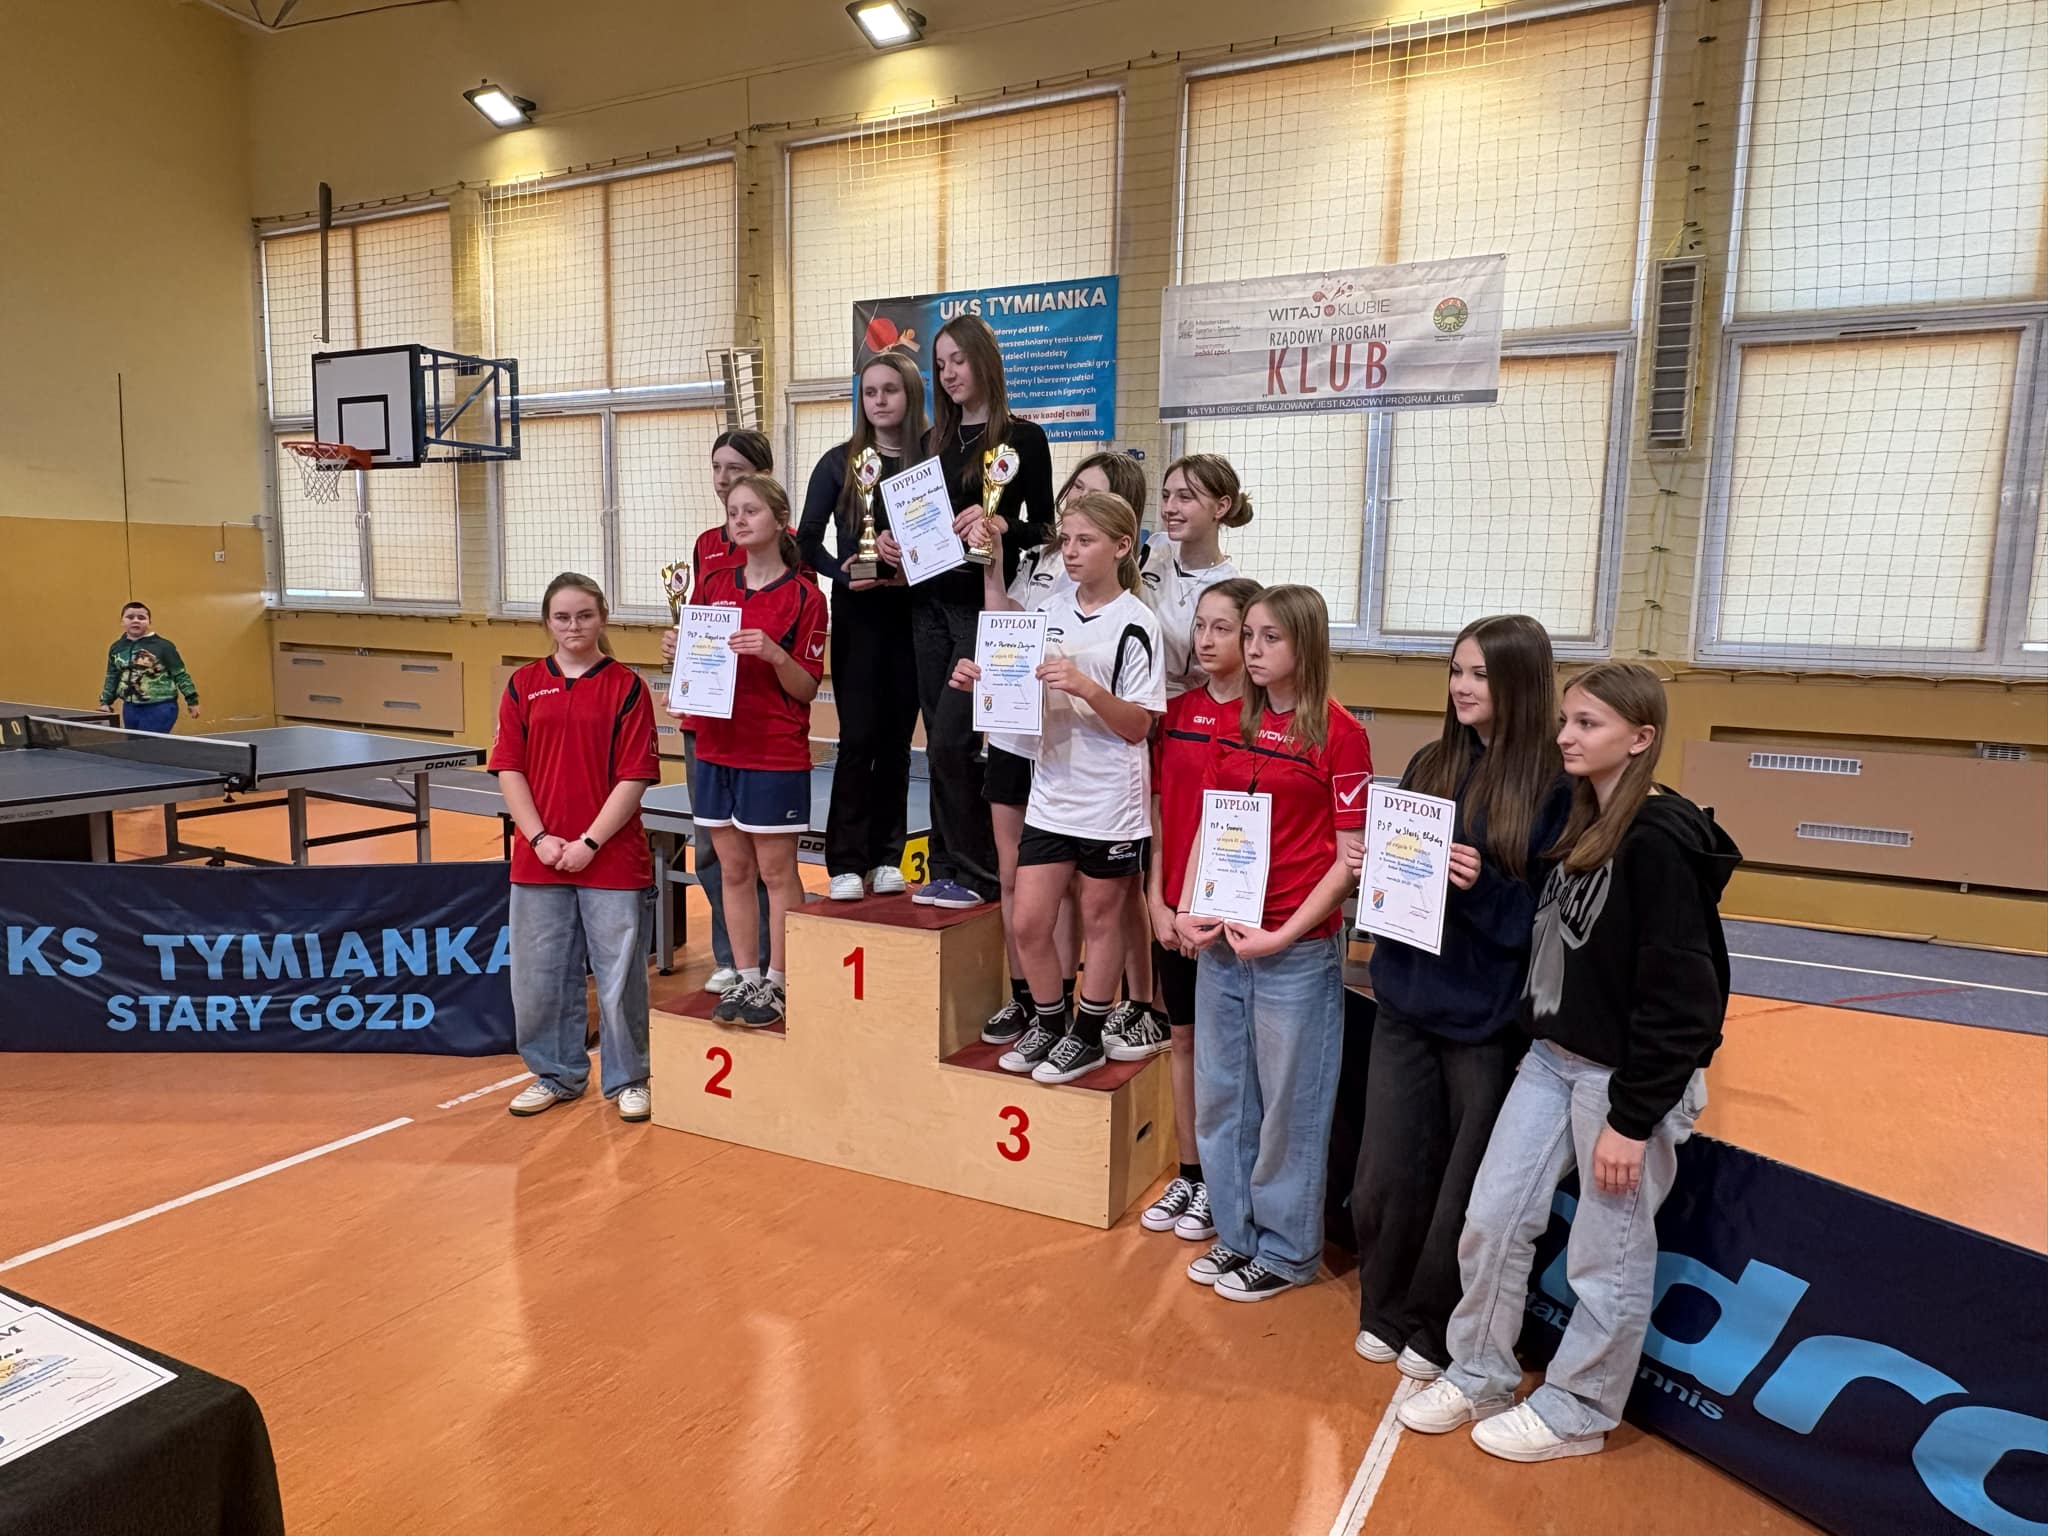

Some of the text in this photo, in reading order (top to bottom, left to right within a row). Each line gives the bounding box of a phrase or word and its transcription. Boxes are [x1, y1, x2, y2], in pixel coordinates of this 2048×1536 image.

[940, 287, 1108, 320] UKS TYMIANKA
[1268, 306, 1321, 321] WITAJ
[1338, 299, 1391, 316] KLUBIE
[1269, 324, 1387, 348] RZĄDOWY PROGRAM
[1187, 408, 1198, 416] NA
[1200, 406, 1216, 415] TYM
[1256, 401, 1316, 412] REALIZOWANY
[1316, 400, 1338, 409] JEST
[1385, 395, 1432, 405] PROGRAM
[892, 467, 932, 492] DYPLOM
[691, 611, 731, 623] DYPLOM
[990, 618, 1036, 629] DYPLOM
[424, 759, 468, 771] DONIC
[1215, 798, 1260, 812] DYPLOM
[1383, 795, 1442, 820] DYPLOM
[910, 851, 926, 884] 3
[6, 925, 103, 979] KS
[842, 946, 864, 1000] 1
[107, 984, 435, 1032] STARY GÓZD
[704, 1046, 733, 1099] 2
[996, 1105, 1031, 1162] 3
[1640, 1366, 1724, 1420] nnis
